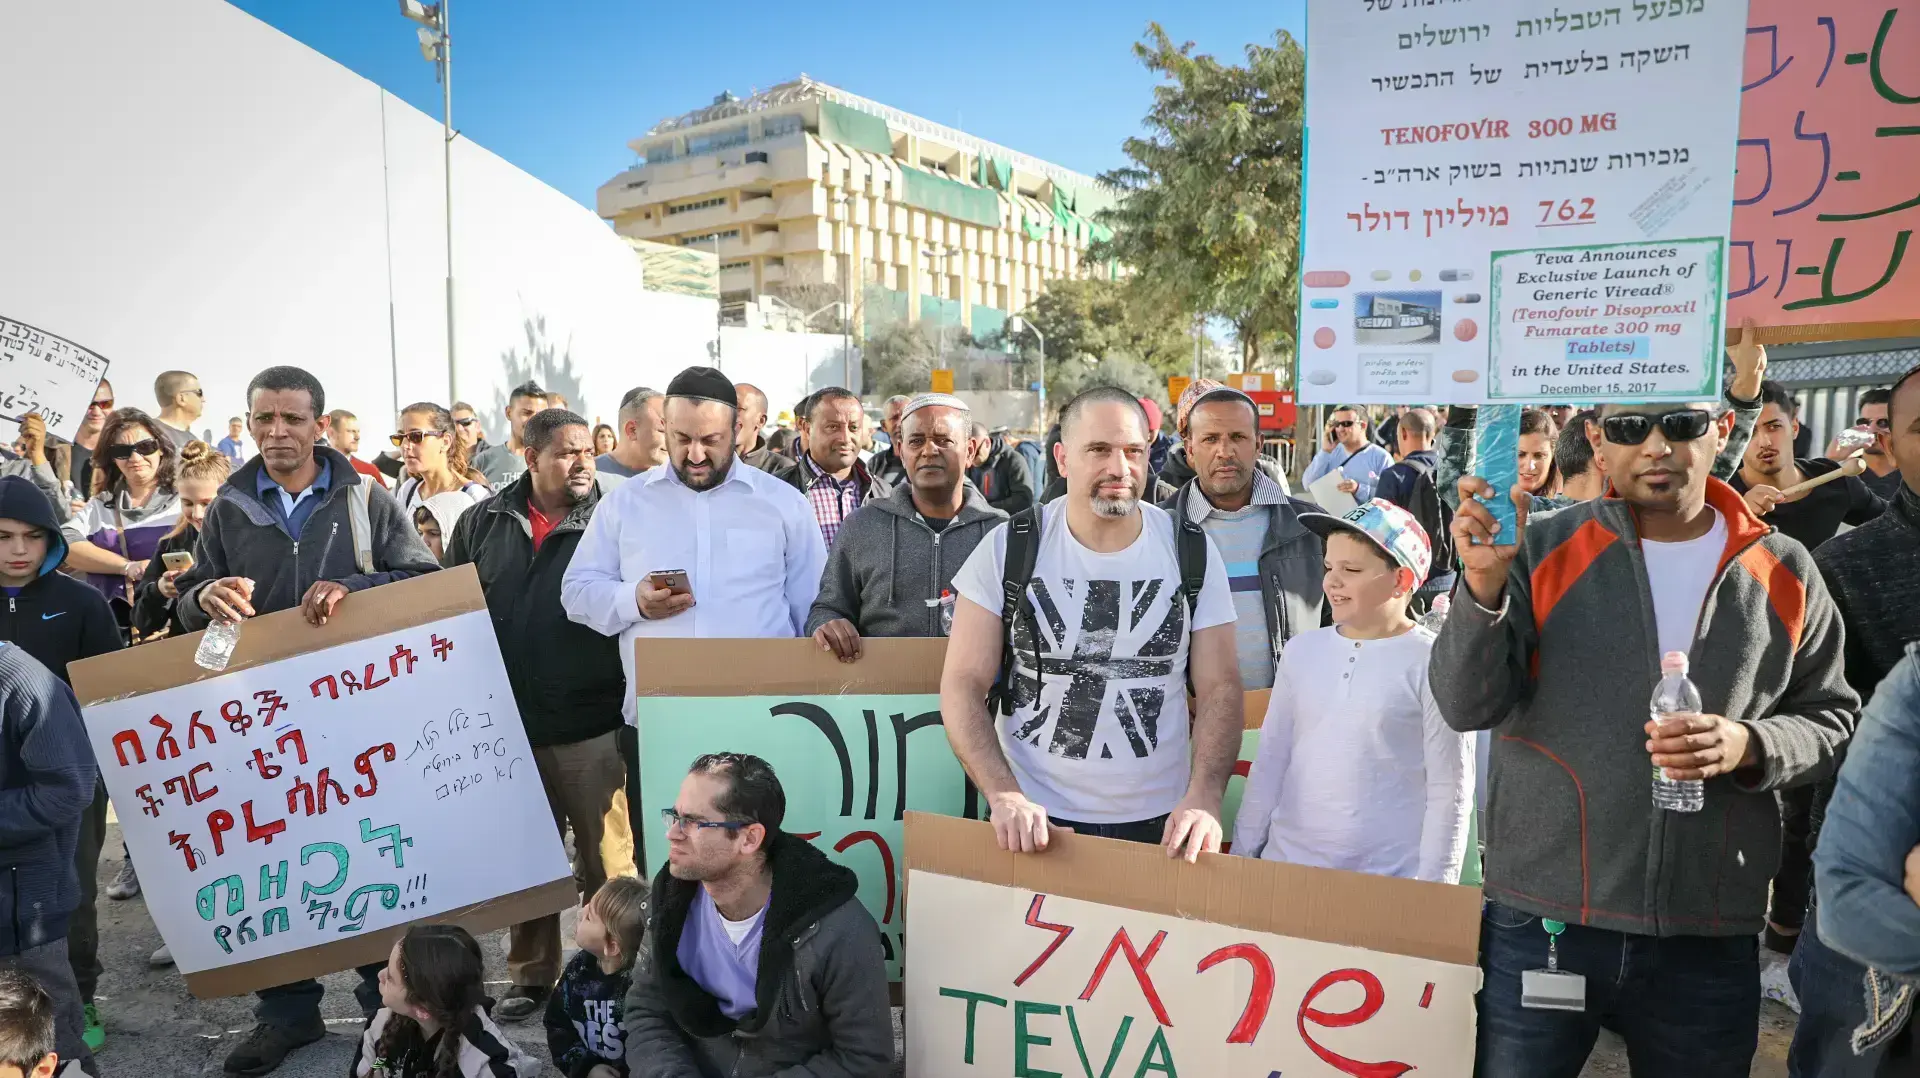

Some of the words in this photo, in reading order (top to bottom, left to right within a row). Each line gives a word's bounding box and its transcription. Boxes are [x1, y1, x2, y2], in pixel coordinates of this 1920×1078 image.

[1515, 7, 1621, 38] הטבליות
[1632, 0, 1704, 22] מפעל
[1398, 23, 1490, 50] ירושלים
[1523, 50, 1608, 79] בלעדית
[1619, 43, 1690, 73] השקה
[1371, 69, 1454, 92] התכשיר
[1469, 63, 1502, 85] של
[1380, 117, 1510, 146] TENOFOVIR
[1528, 116, 1573, 139] 300
[1579, 112, 1617, 134] MG
[1518, 155, 1599, 179] שנתיות
[1607, 147, 1690, 171] מכירות
[1448, 161, 1502, 186] בשוק
[1347, 202, 1410, 232] דולר
[1423, 197, 1509, 238] מיליון
[1538, 197, 1596, 226] 762
[1535, 252, 1574, 265] Teva
[1580, 247, 1677, 263] Announces
[1516, 269, 1598, 285] Exclusive
[1603, 264, 1671, 280] Launch
[1677, 262, 1697, 279] of
[1533, 287, 1598, 301] Generic
[1511, 305, 1598, 323] (Tenofovir
[1603, 300, 1697, 319] Disoproxil
[1524, 323, 1609, 338] Fumarate
[1613, 321, 1649, 336] 300
[1654, 323, 1681, 337] mg
[28, 342, 42, 358] על
[51, 340, 69, 355] רב
[1567, 340, 1636, 355] Tablets)
[1511, 364, 1529, 376] in
[1533, 363, 1561, 376] the
[1567, 362, 1626, 375] United
[1629, 361, 1690, 375] States.
[1540, 383, 1601, 395] December
[1606, 383, 1623, 395] 15,
[1627, 382, 1656, 393] 2017
[494, 757, 523, 782] לא
[1013, 893, 1436, 1078] ישראל
[583, 1000, 616, 1024] THE
[939, 986, 1179, 1078] TEVA
